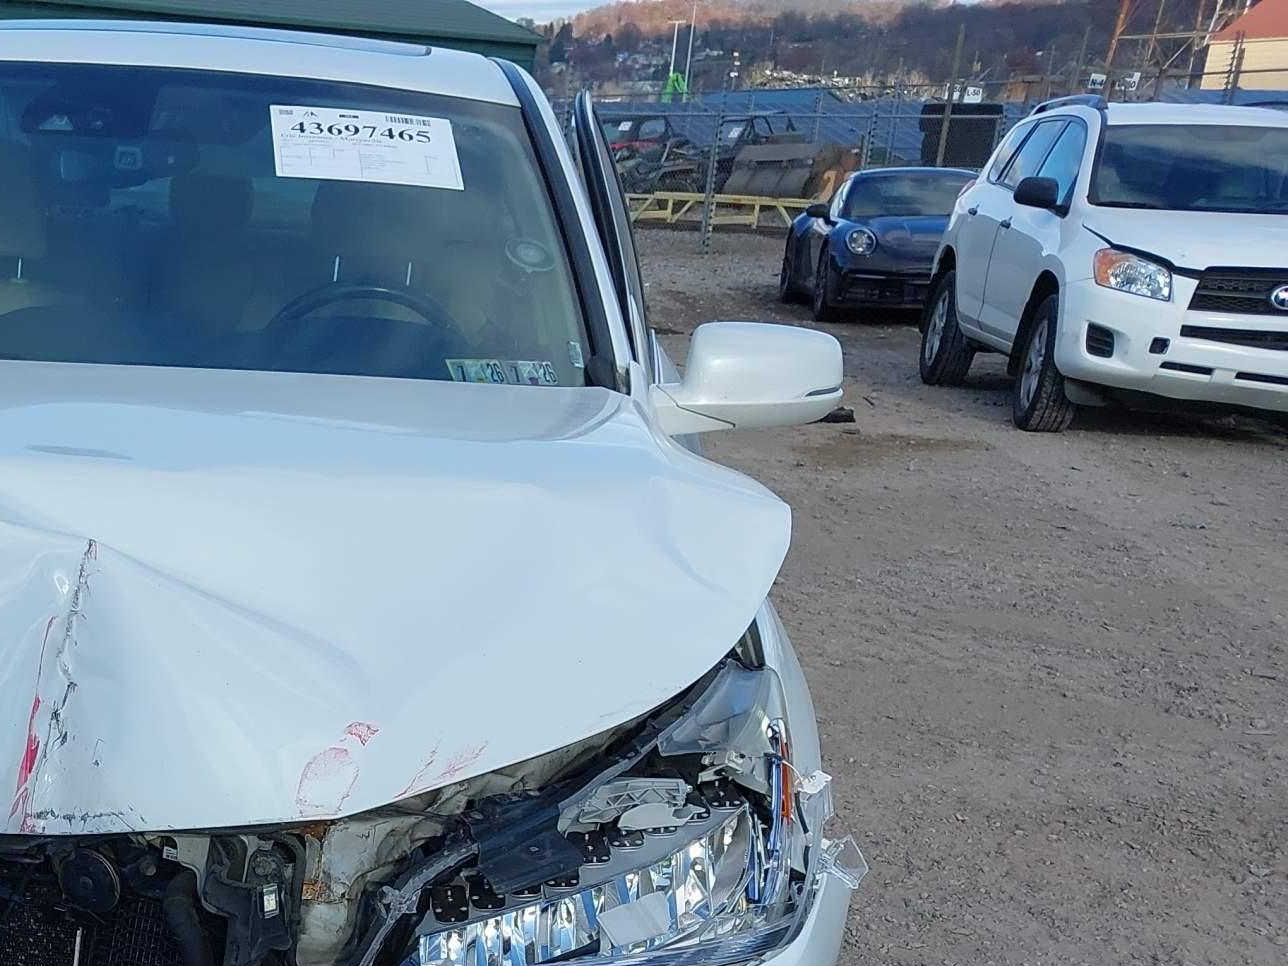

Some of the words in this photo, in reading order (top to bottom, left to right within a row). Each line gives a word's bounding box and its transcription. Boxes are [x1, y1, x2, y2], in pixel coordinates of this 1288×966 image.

[290, 121, 432, 144] 43697465
[486, 363, 505, 383] 26
[538, 363, 557, 383] 26
